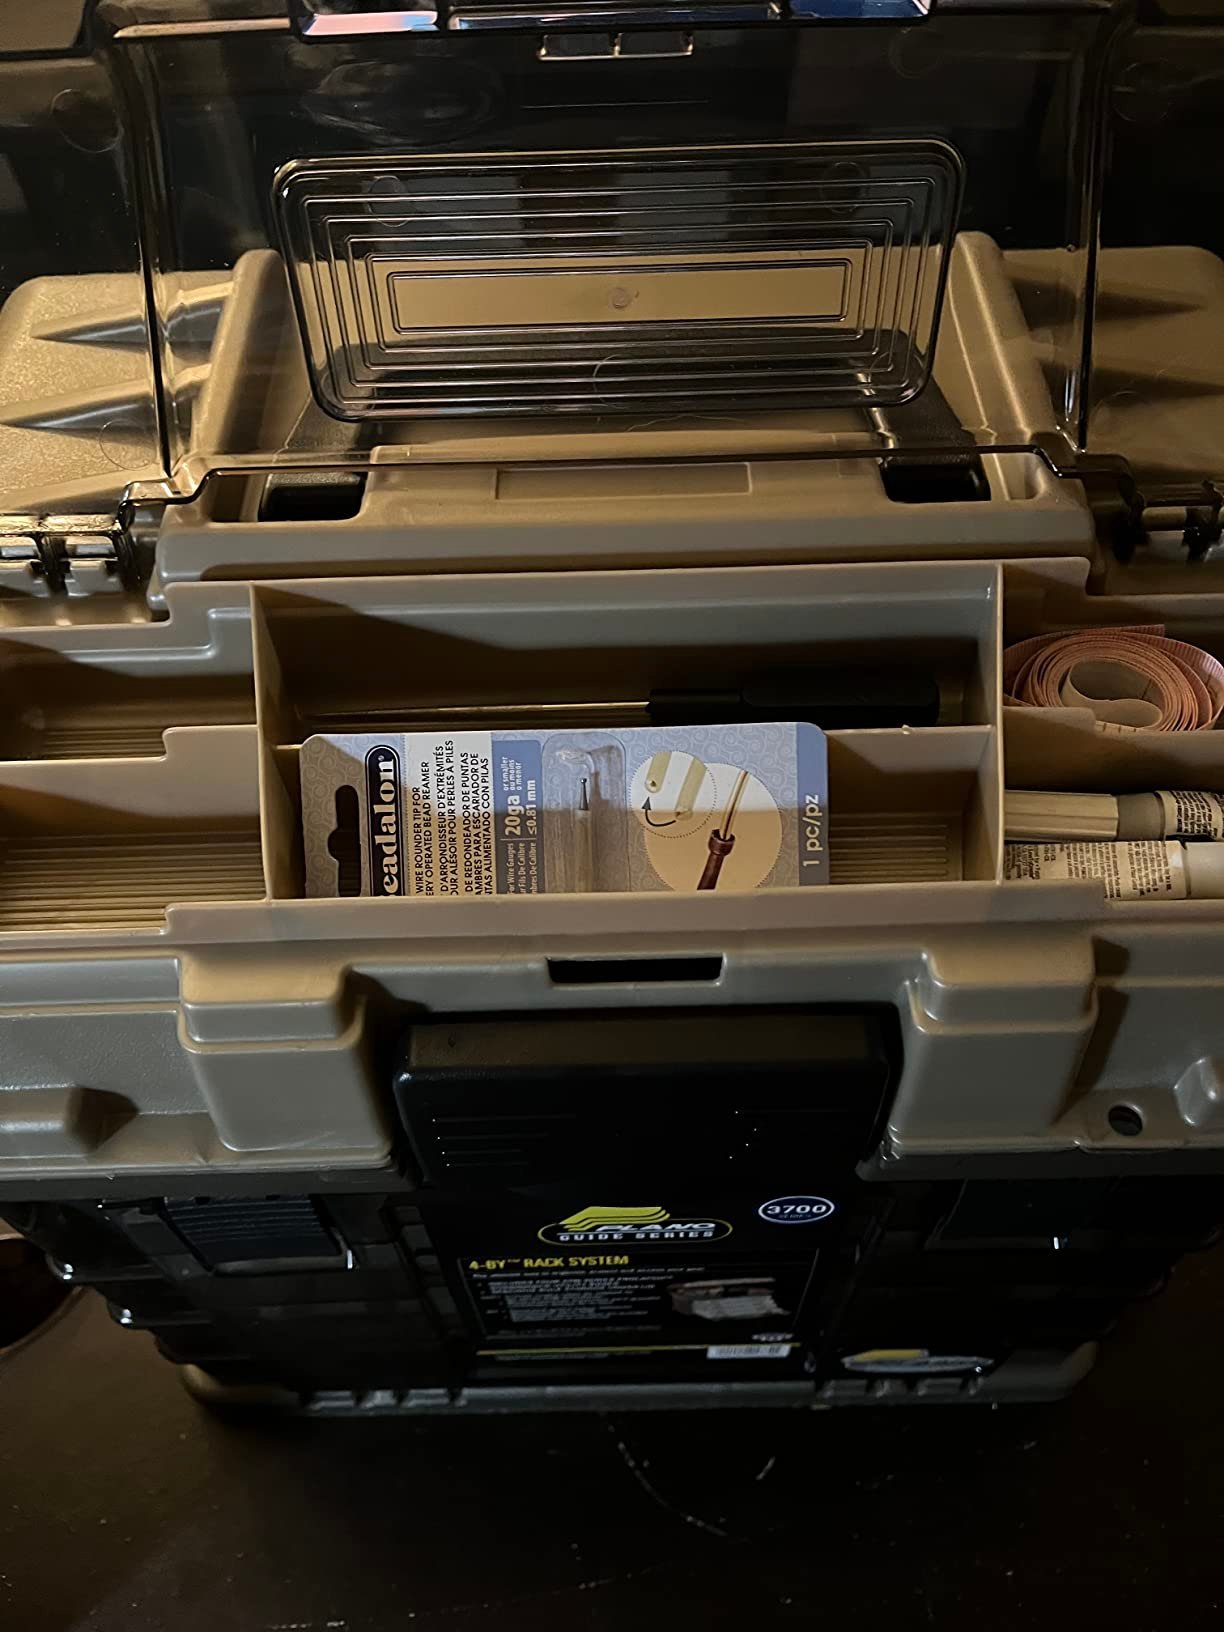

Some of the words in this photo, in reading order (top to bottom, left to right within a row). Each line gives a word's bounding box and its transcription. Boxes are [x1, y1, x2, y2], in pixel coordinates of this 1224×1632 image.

[444, 740, 454, 763] PILES
[470, 753, 478, 765] DE
[421, 762, 430, 800] REAMER
[433, 746, 445, 808] D'EXTRÉMITÉS
[460, 752, 469, 788] PUNTAS
[480, 758, 488, 783] PILAS
[500, 756, 508, 782] smaller
[412, 787, 420, 805] FOR
[446, 776, 455, 806] PERLES
[462, 790, 470, 802] DE
[481, 786, 490, 808] CON
[509, 782, 515, 790] ou
[527, 780, 536, 801] mm
[470, 768, 481, 829] ESCARIADOR
[413, 808, 421, 820] TIP
[422, 803, 431, 827] BEAD
[447, 809, 456, 834] POUR
[504, 795, 524, 836] 20ga
[802, 794, 823, 852] pc/pz
[373, 759, 398, 897] eadalon
[414, 823, 423, 868] ROUNDER
[462, 804, 472, 878] REDONDEADOR
[473, 832, 482, 856] PARA
[482, 811, 492, 872] ALIMENTADO
[423, 830, 433, 877] OPERATED
[506, 843, 516, 867] Gauges
[517, 842, 525, 866] Calibre
[528, 842, 537, 865] Calibre
[415, 871, 424, 893] WIRE
[506, 868, 514, 884] Wire
[518, 866, 526, 875] De
[529, 866, 537, 874] De
[464, 880, 473, 892] DE
[766, 1204, 827, 1215] 3700
[559, 1232, 624, 1242] GUIDE
[634, 1230, 714, 1240] SERIES
[523, 1256, 566, 1269] RACK
[568, 1255, 630, 1267] SYSTEM
